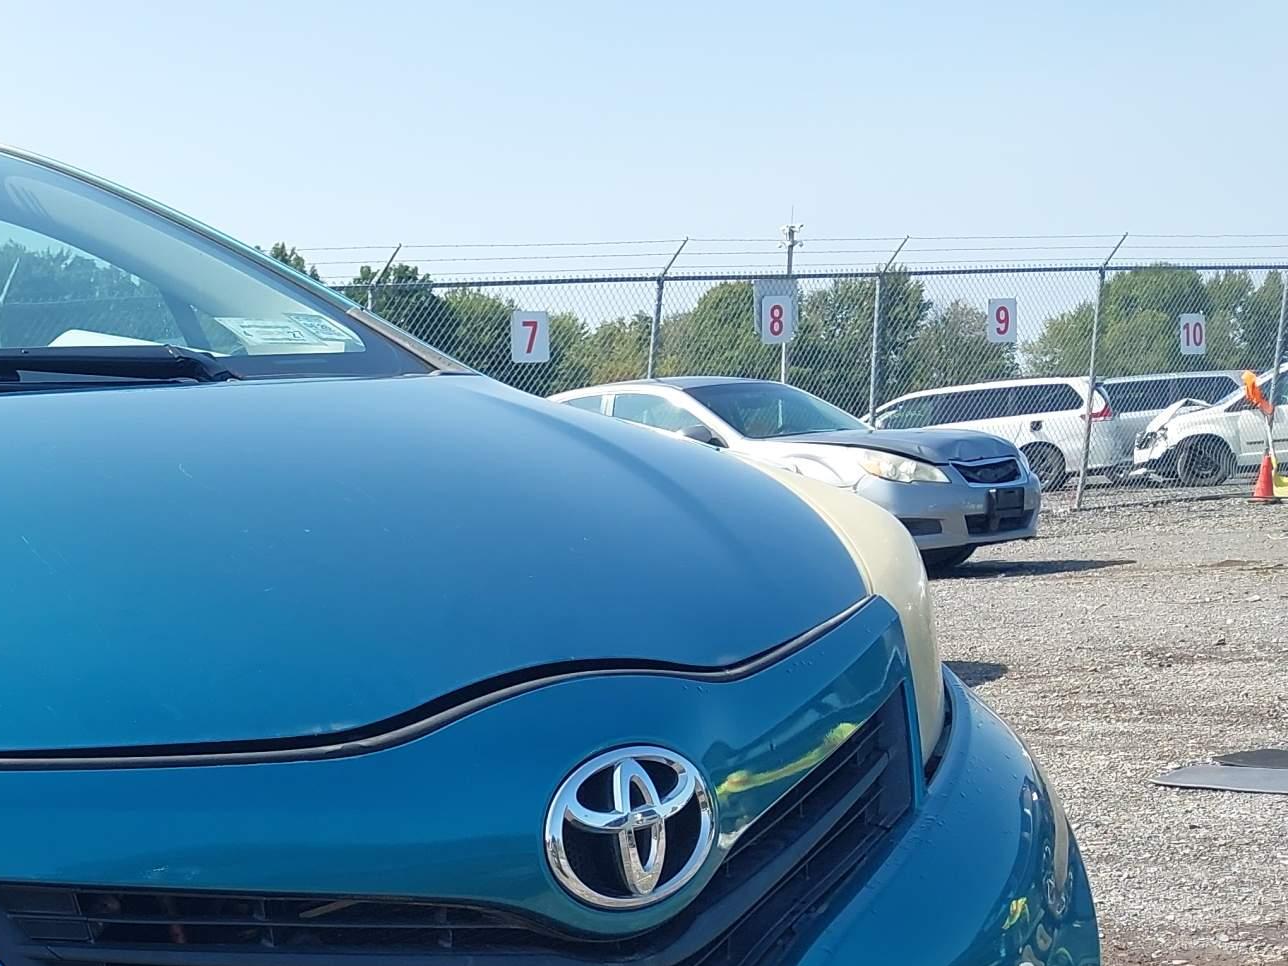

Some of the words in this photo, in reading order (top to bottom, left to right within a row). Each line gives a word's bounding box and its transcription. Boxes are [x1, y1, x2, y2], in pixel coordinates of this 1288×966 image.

[769, 303, 784, 337] 8
[995, 305, 1010, 336] 9
[1182, 321, 1204, 347] 10
[521, 320, 538, 354] 7
